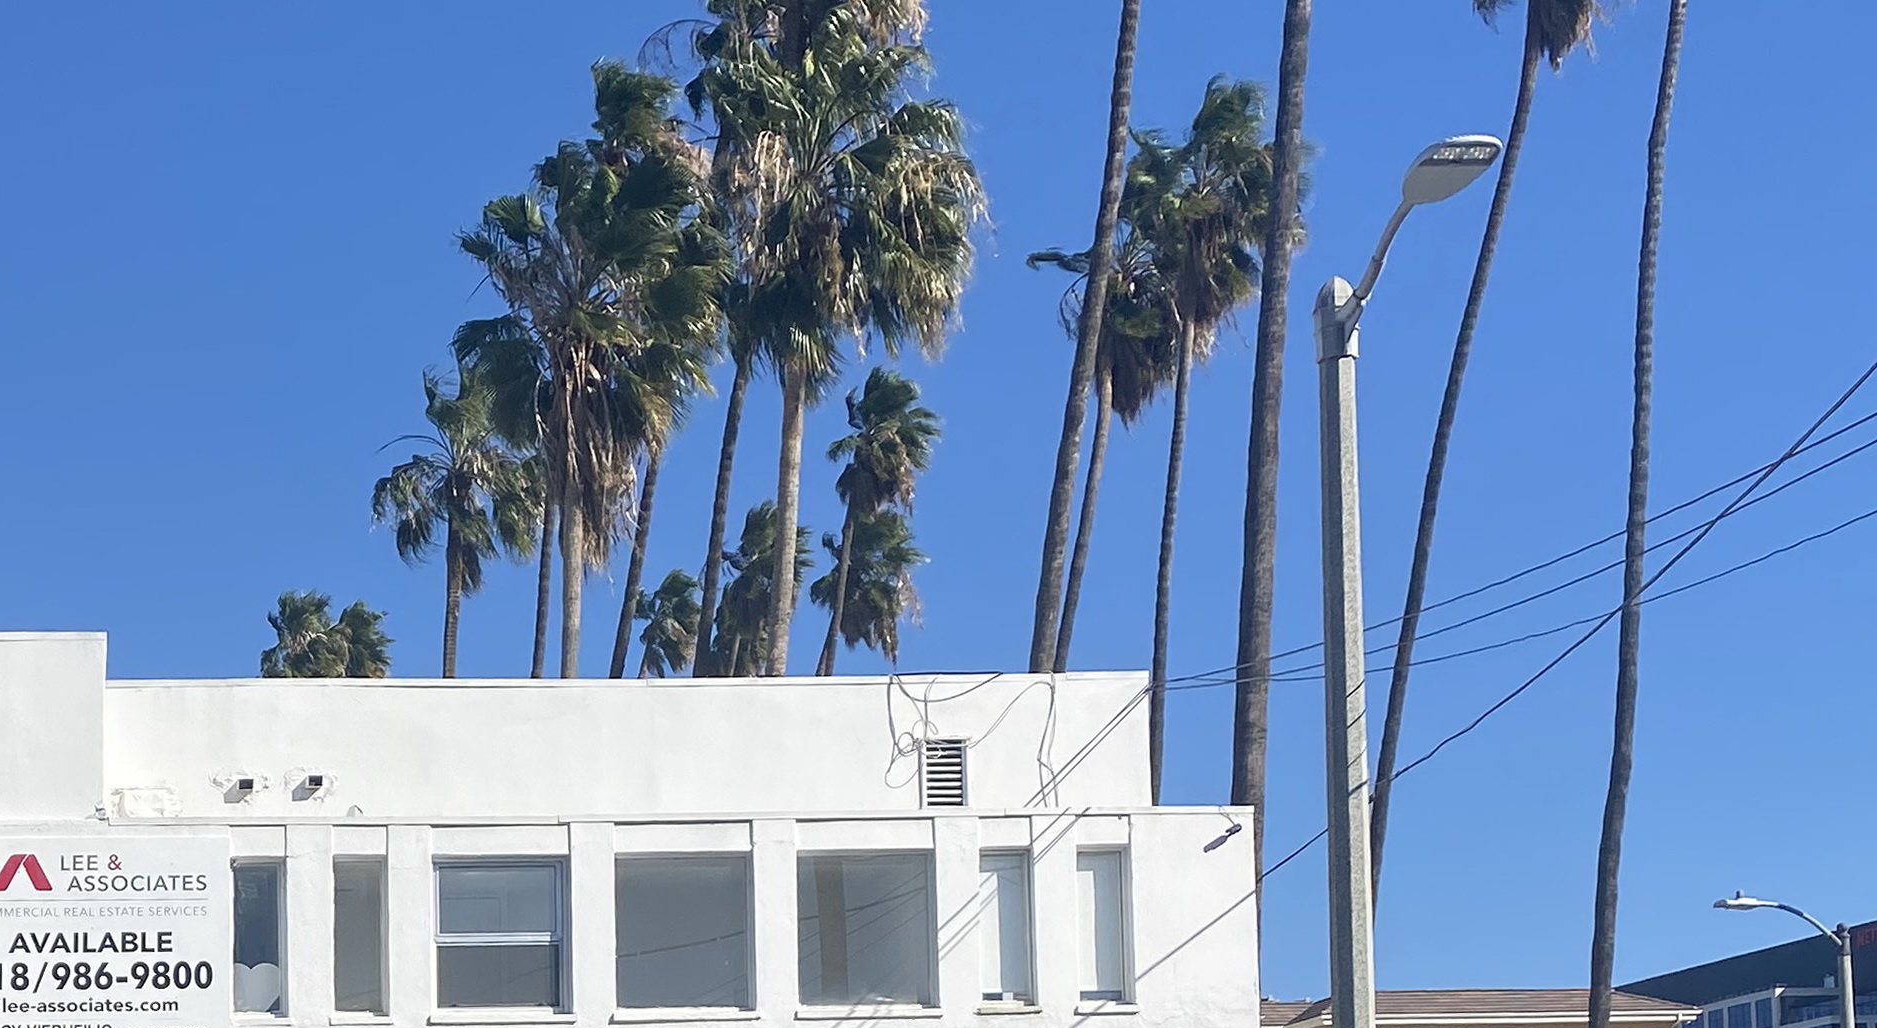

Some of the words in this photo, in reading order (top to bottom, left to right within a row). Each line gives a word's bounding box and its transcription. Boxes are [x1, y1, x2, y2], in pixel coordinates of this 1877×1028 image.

[60, 855, 98, 871] LEE
[107, 854, 122, 871] &
[67, 875, 207, 892] ASSOCIATES
[64, 906, 96, 917] REAL
[99, 906, 144, 917] ESTATE
[148, 905, 207, 917] SERVICES
[8, 931, 173, 953] AVAILABLE
[2, 997, 179, 1013] lee-associates.com
